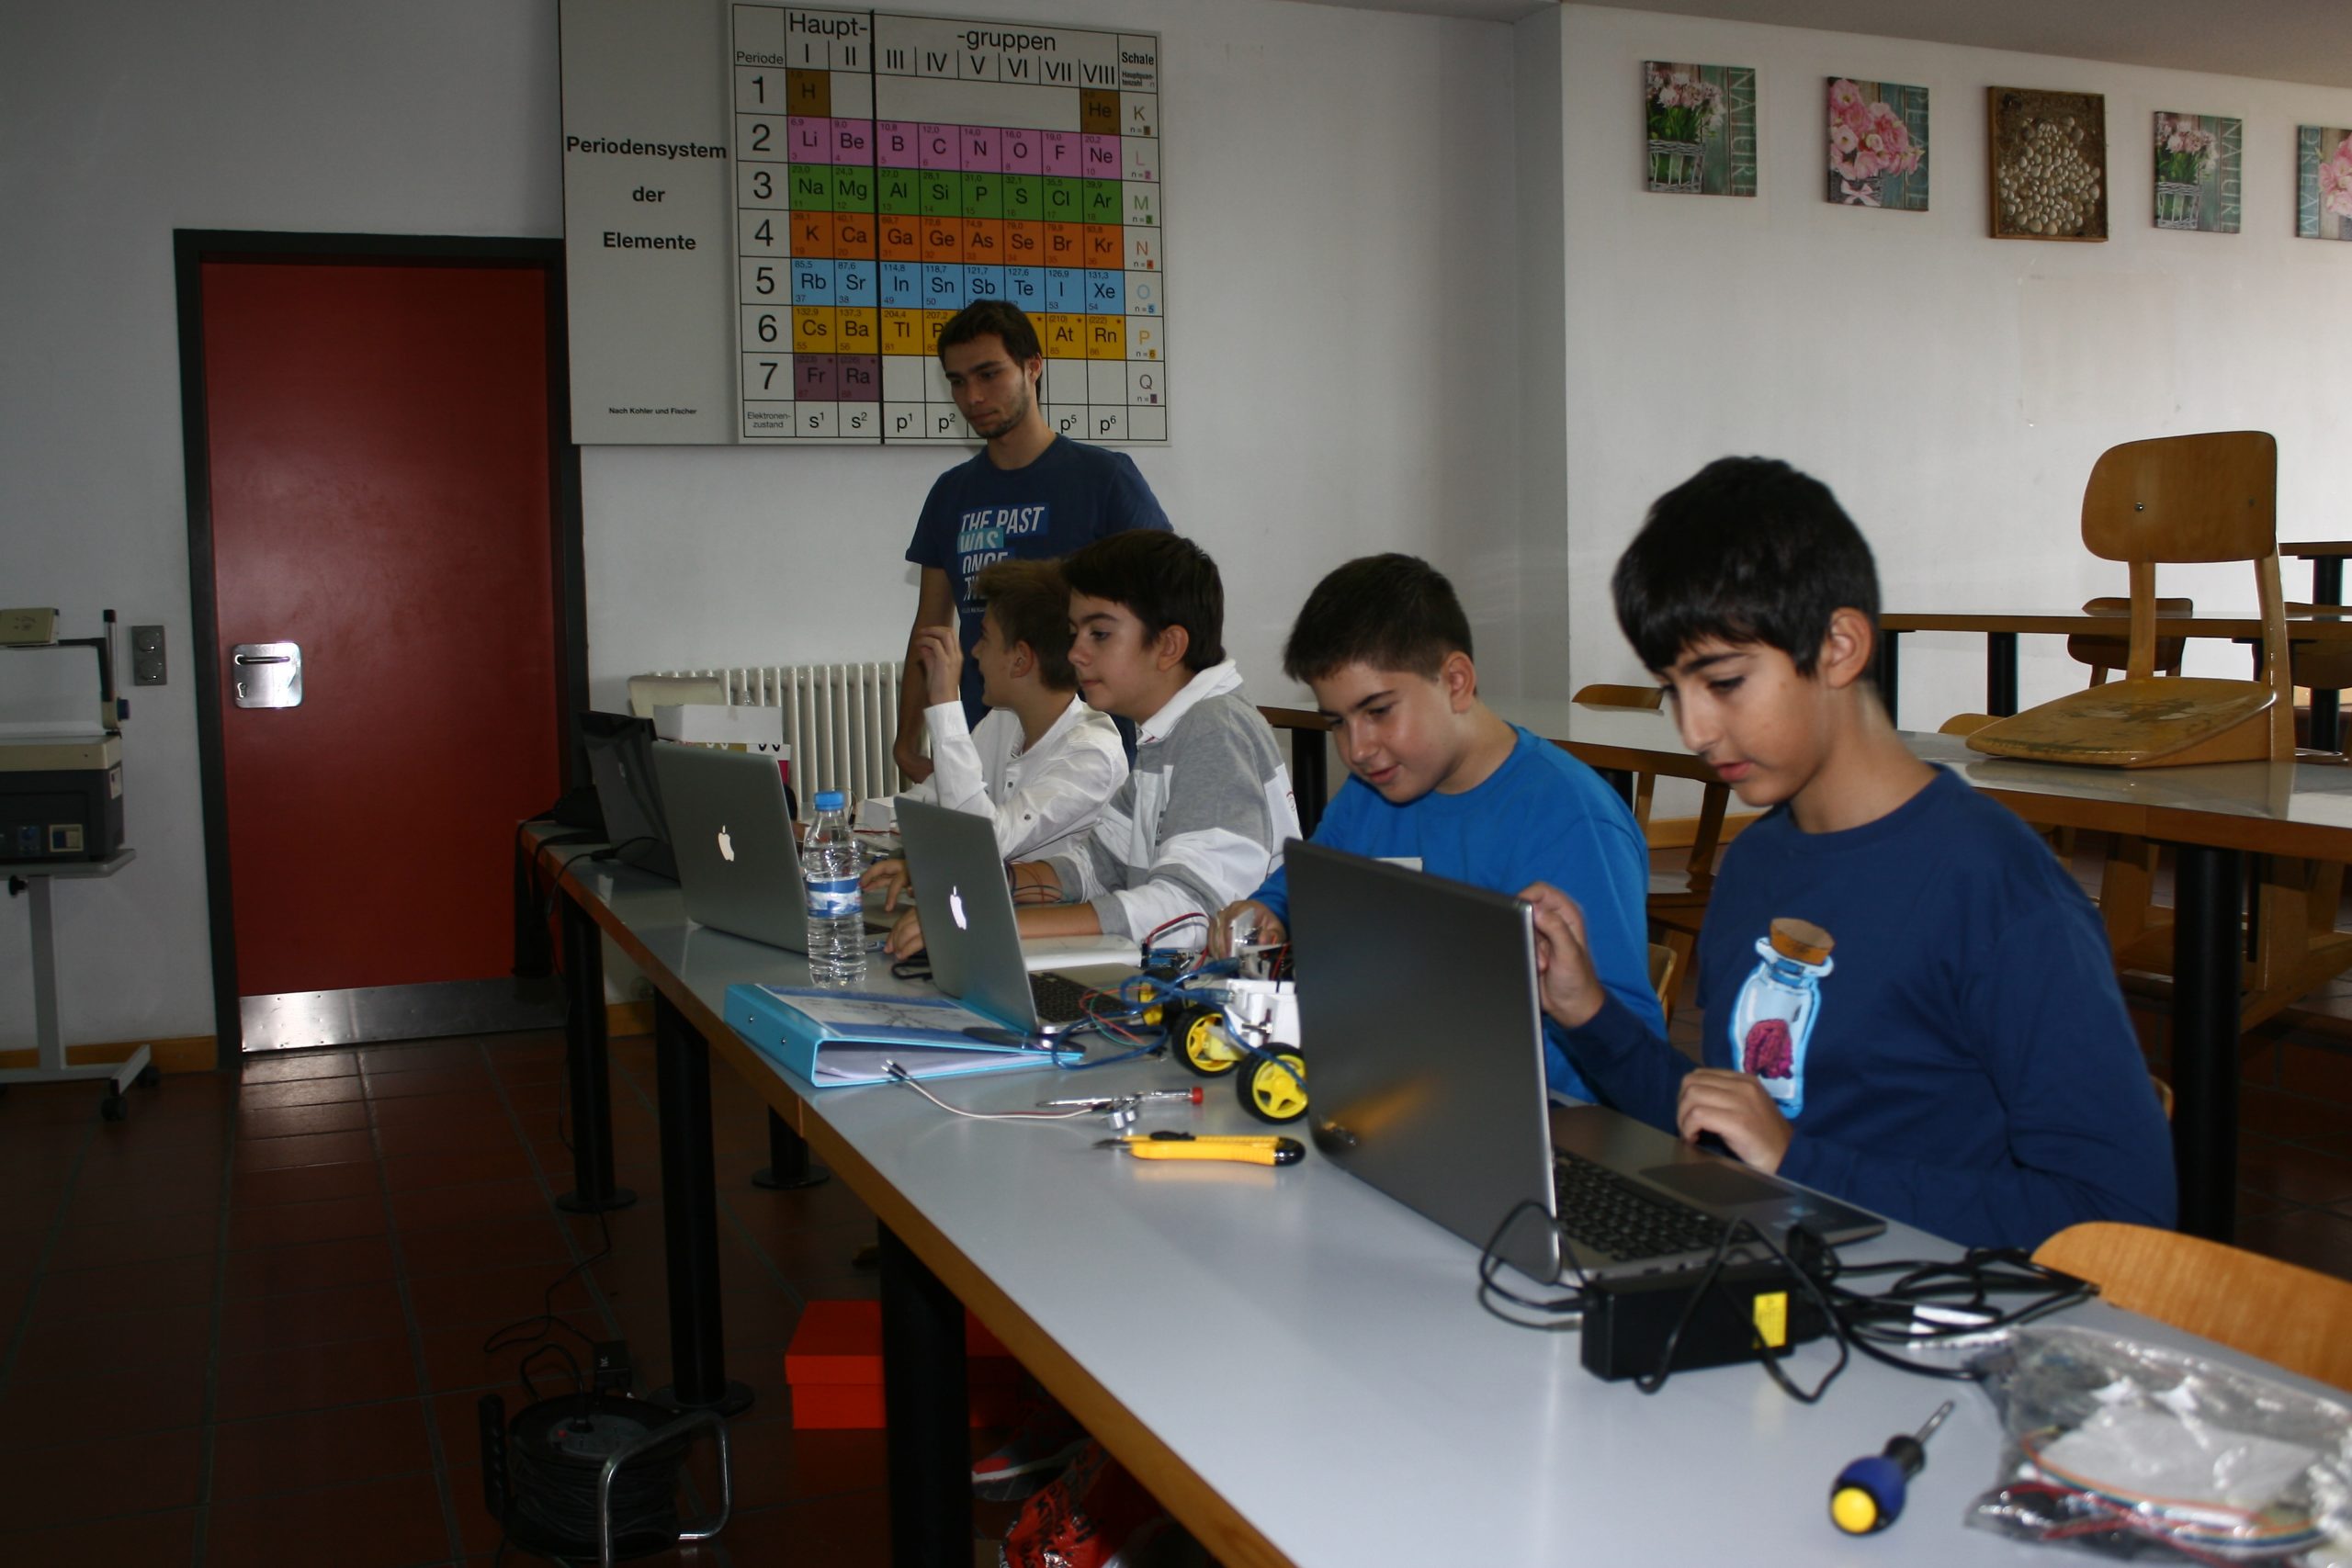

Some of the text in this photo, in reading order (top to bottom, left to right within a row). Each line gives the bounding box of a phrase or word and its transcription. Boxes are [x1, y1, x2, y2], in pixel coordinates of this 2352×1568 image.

[790, 12, 1056, 52] Haupt- -gruppen
[736, 51, 782, 65] Periode
[805, 43, 809, 63] I
[845, 46, 856, 66] II
[887, 49, 904, 70] III
[927, 52, 947, 72] IV
[970, 55, 986, 75] V
[1007, 58, 1028, 78] VI
[1045, 61, 1071, 82] VII
[1083, 63, 1115, 85] VIII
[1122, 52, 1154, 65] Schale
[752, 76, 764, 104] 1
[801, 82, 815, 99] H
[1088, 101, 1111, 118] He
[1133, 105, 1145, 121] K
[752, 123, 770, 152] 2
[802, 130, 817, 147] Li
[840, 132, 864, 149] Be
[1729, 70, 1756, 195] NATURE
[566, 136, 727, 160] Periodensystem
[891, 135, 904, 151] B
[932, 137, 946, 154] C
[974, 140, 986, 156] N
[1013, 142, 1027, 158] O
[1055, 144, 1065, 160] F
[1090, 147, 1112, 163] Ne
[1135, 150, 1144, 166] L
[2221, 120, 2242, 231] NATURE
[753, 171, 772, 199] 3
[798, 177, 824, 195] Na
[839, 179, 867, 200] Mg
[932, 183, 948, 200] Si
[975, 186, 987, 201] P
[632, 186, 665, 202] der
[1015, 187, 1027, 204] S
[1093, 192, 1112, 208] Ar
[1134, 195, 1148, 210] M
[603, 231, 696, 250] Elemente
[754, 219, 774, 247] 4
[806, 225, 819, 241] K
[841, 225, 867, 243] Ca
[887, 228, 913, 245] Ga
[929, 229, 955, 246] Ge
[971, 231, 993, 248] As
[1011, 233, 1034, 250] Se
[1053, 235, 1072, 251] Br
[1094, 237, 1113, 252] Kr
[1136, 241, 1147, 256] N
[756, 266, 775, 295] 5
[801, 272, 826, 289] Rb
[846, 273, 866, 290] Sr
[894, 275, 909, 291] In
[931, 276, 954, 293] Sn
[972, 278, 995, 294] Sb
[1014, 279, 1033, 296] Te
[1094, 282, 1115, 299] Xe
[1137, 284, 1150, 299] O
[758, 314, 777, 343] 6
[802, 319, 827, 336] Cs
[845, 320, 869, 337] Ba
[933, 322, 944, 338] P
[1055, 326, 1073, 341] At
[1094, 326, 1116, 342] Rn
[1139, 330, 1150, 344] P
[759, 362, 778, 390] 7
[807, 366, 825, 383] Fr
[846, 367, 870, 384] Ra
[1139, 374, 1152, 390] Q
[747, 412, 790, 420] Elektronen-
[753, 420, 782, 428] zustand
[961, 507, 1045, 534] THE PAST
